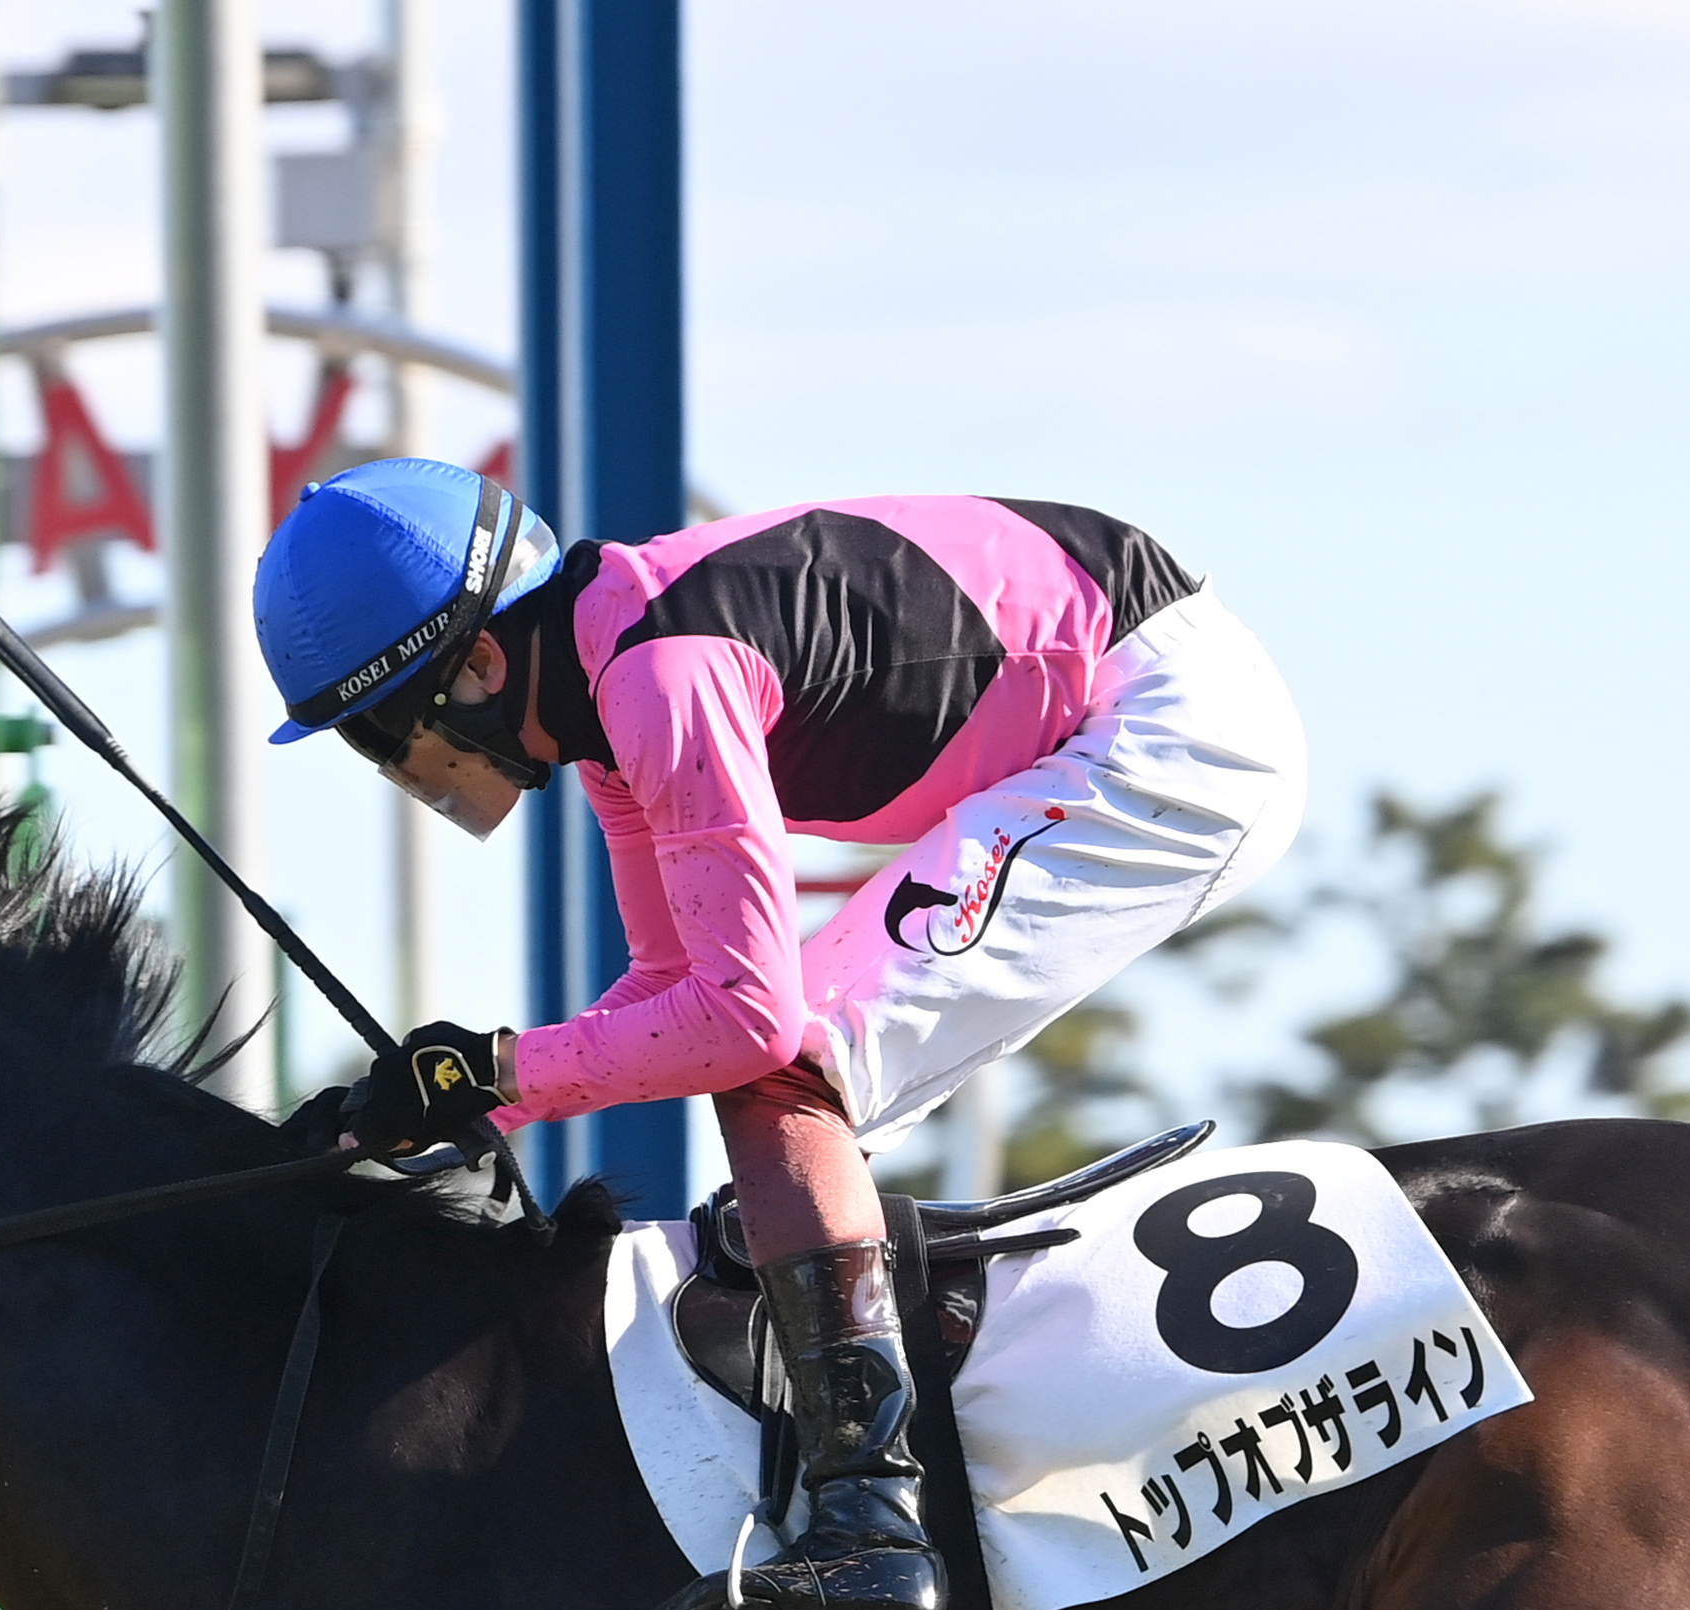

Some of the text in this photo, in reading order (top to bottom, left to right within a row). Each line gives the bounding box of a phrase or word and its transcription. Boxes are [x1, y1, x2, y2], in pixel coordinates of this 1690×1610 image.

[336, 602, 457, 702] KOSEI MIUR
[955, 827, 1011, 943] Kosei
[1133, 1171, 1359, 1374] 8
[1099, 1326, 1485, 1573] トップオブザライン
